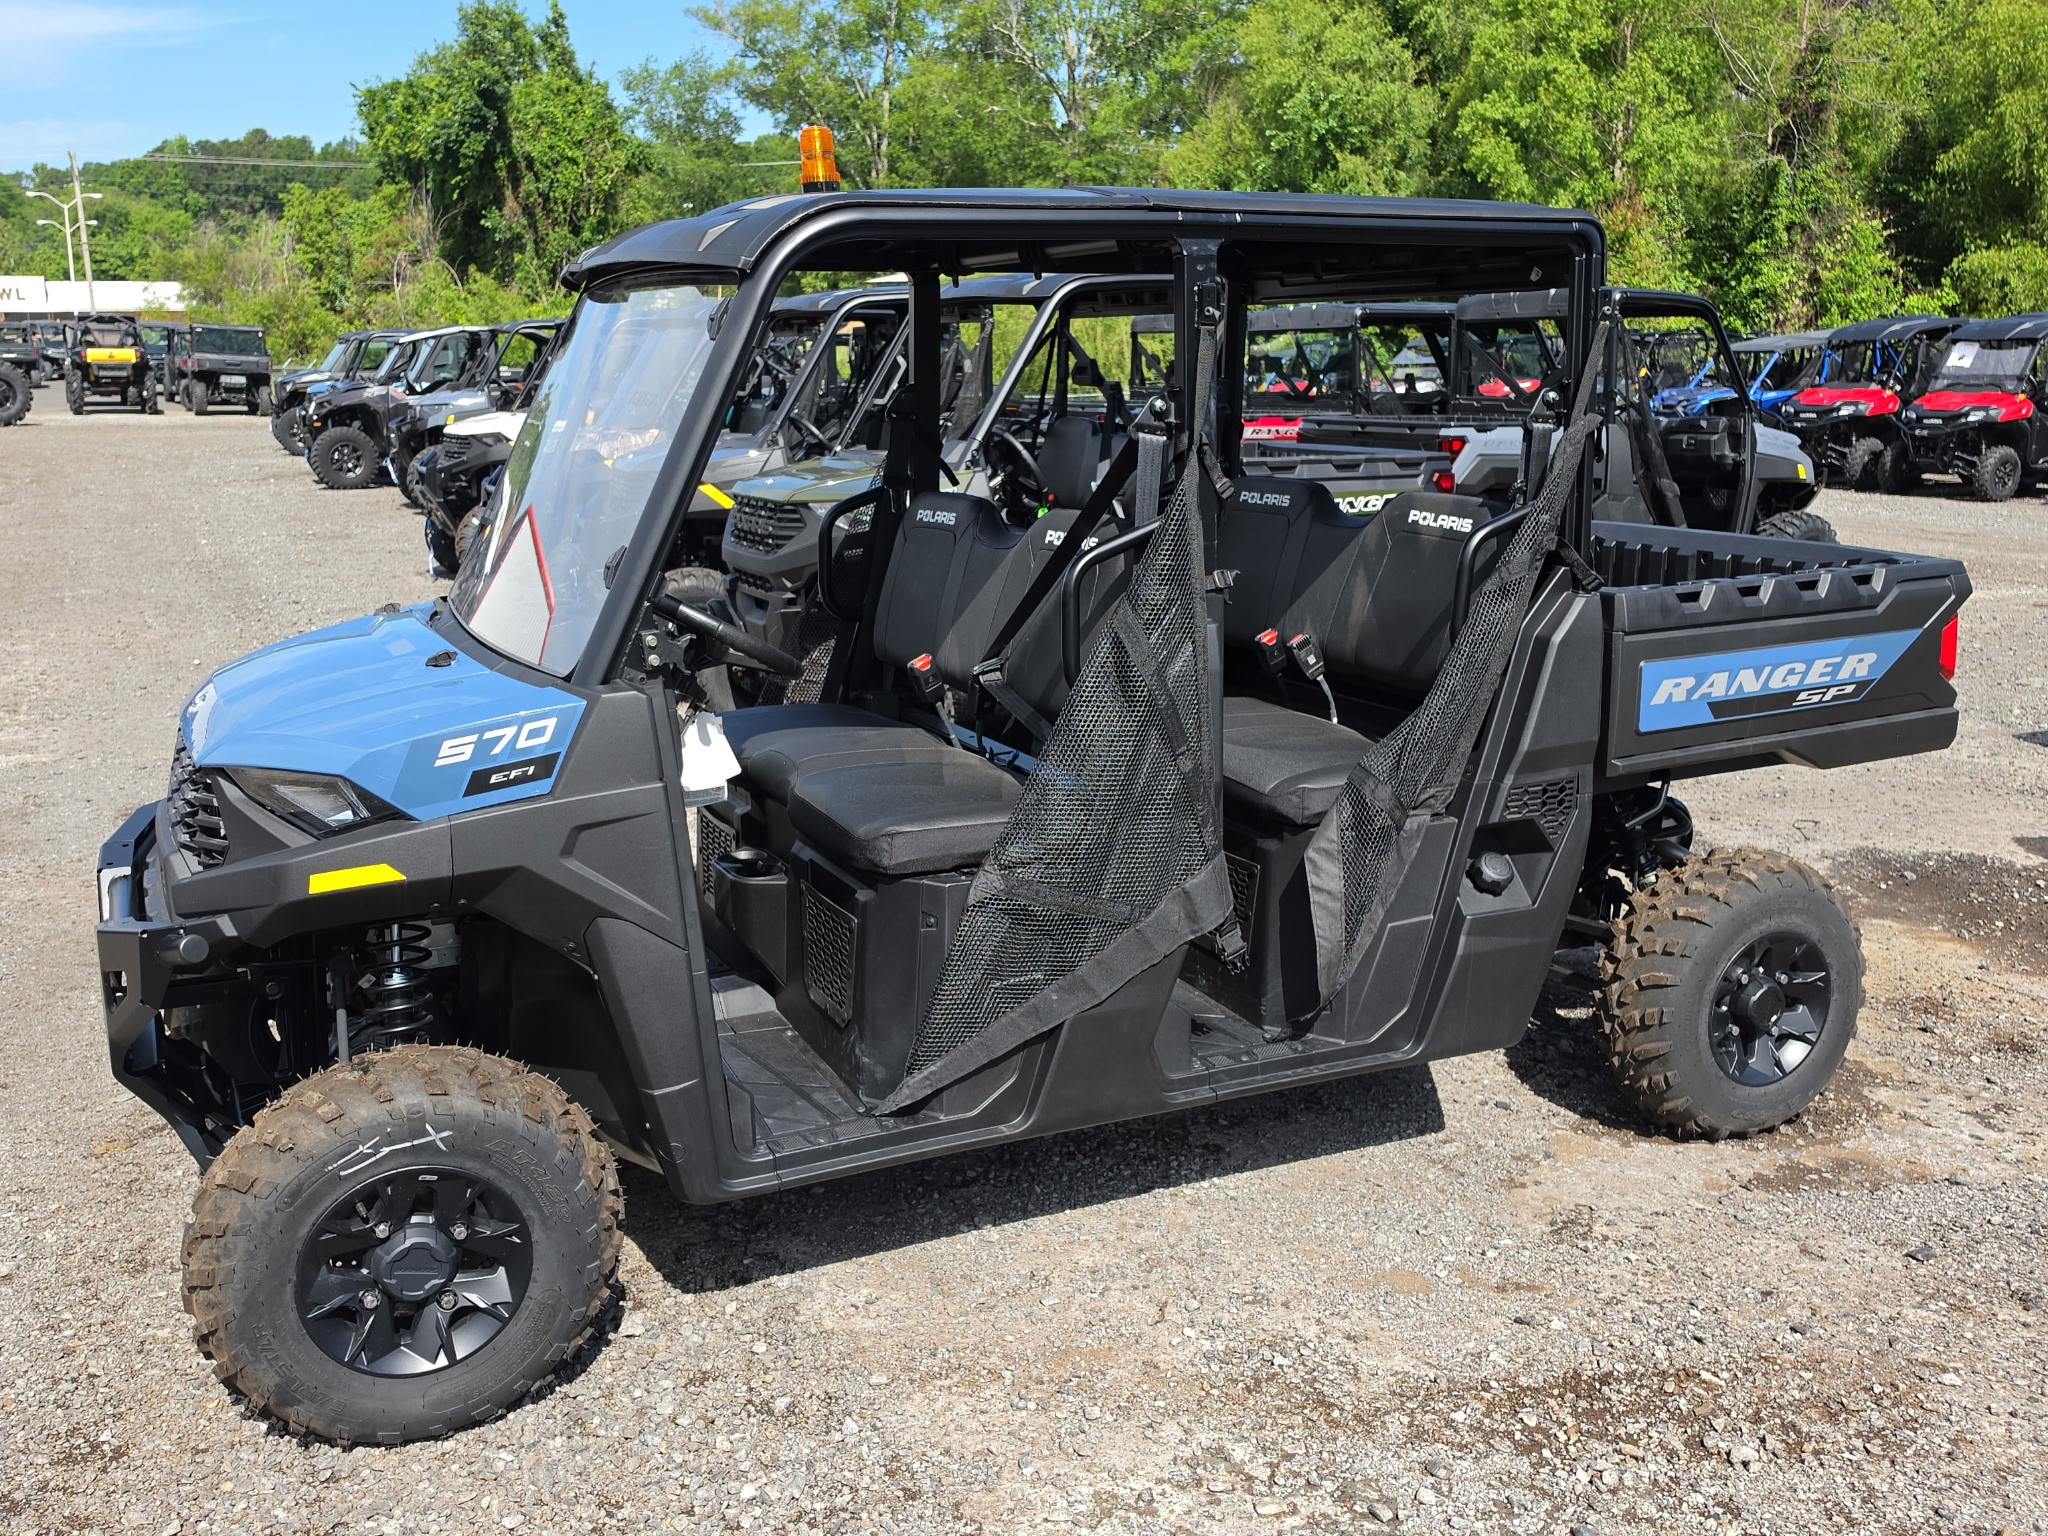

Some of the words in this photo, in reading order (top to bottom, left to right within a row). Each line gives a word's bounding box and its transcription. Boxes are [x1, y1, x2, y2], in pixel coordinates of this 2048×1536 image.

[1249, 428, 1297, 436] RANG
[1239, 491, 1291, 507] POLARIS
[916, 509, 957, 526] POLARIS
[1408, 509, 1474, 534] POLARIS
[1044, 530, 1099, 551] POIS
[1650, 652, 1878, 706] RANGER
[1792, 684, 1857, 706] SP
[433, 717, 558, 768] 570
[489, 765, 536, 784] EFI
[486, 1139, 573, 1223] AT489
